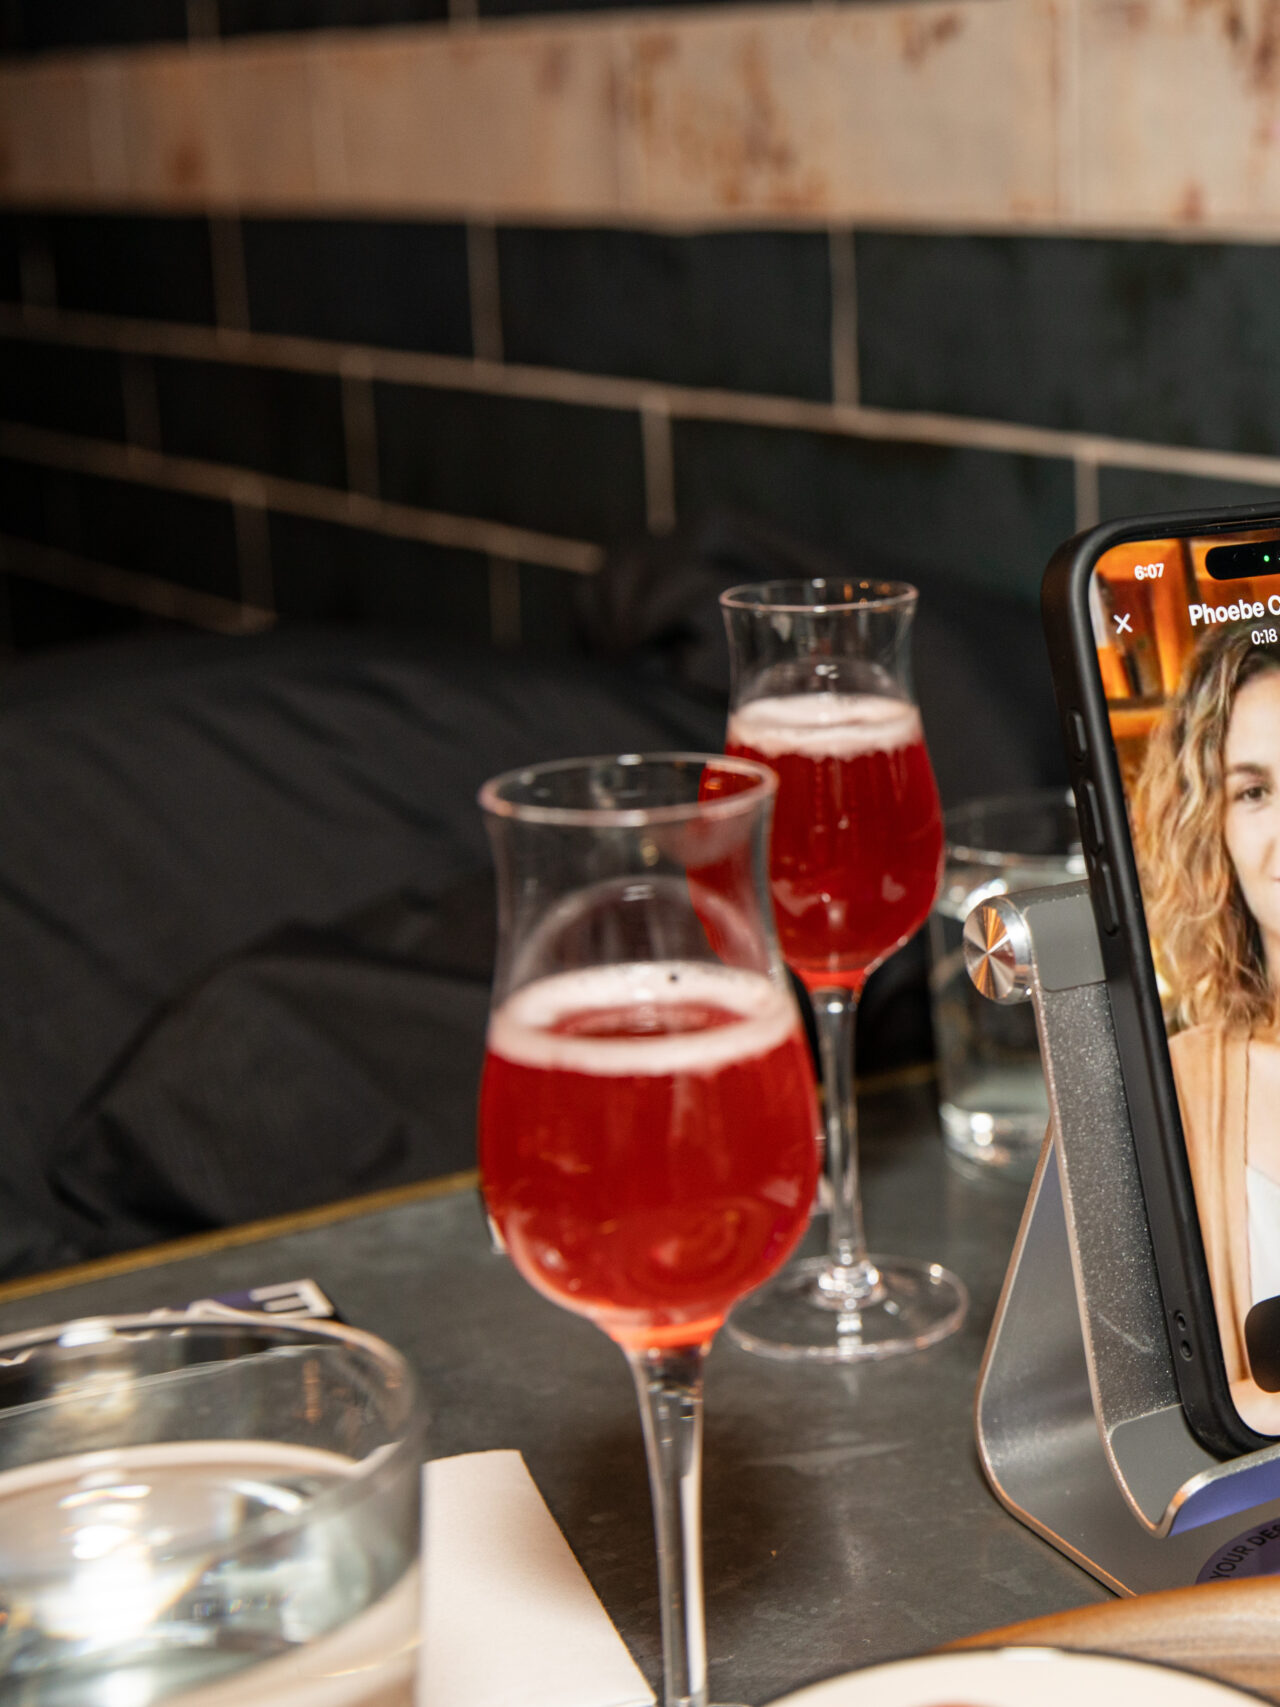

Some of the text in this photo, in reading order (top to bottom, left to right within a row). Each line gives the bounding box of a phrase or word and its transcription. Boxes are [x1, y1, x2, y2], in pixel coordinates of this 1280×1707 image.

[1134, 562, 1164, 581] 6:07
[1188, 598, 1265, 627] Phoebe
[1250, 628, 1278, 646] 0:18
[1207, 1544, 1256, 1582] YOUR
